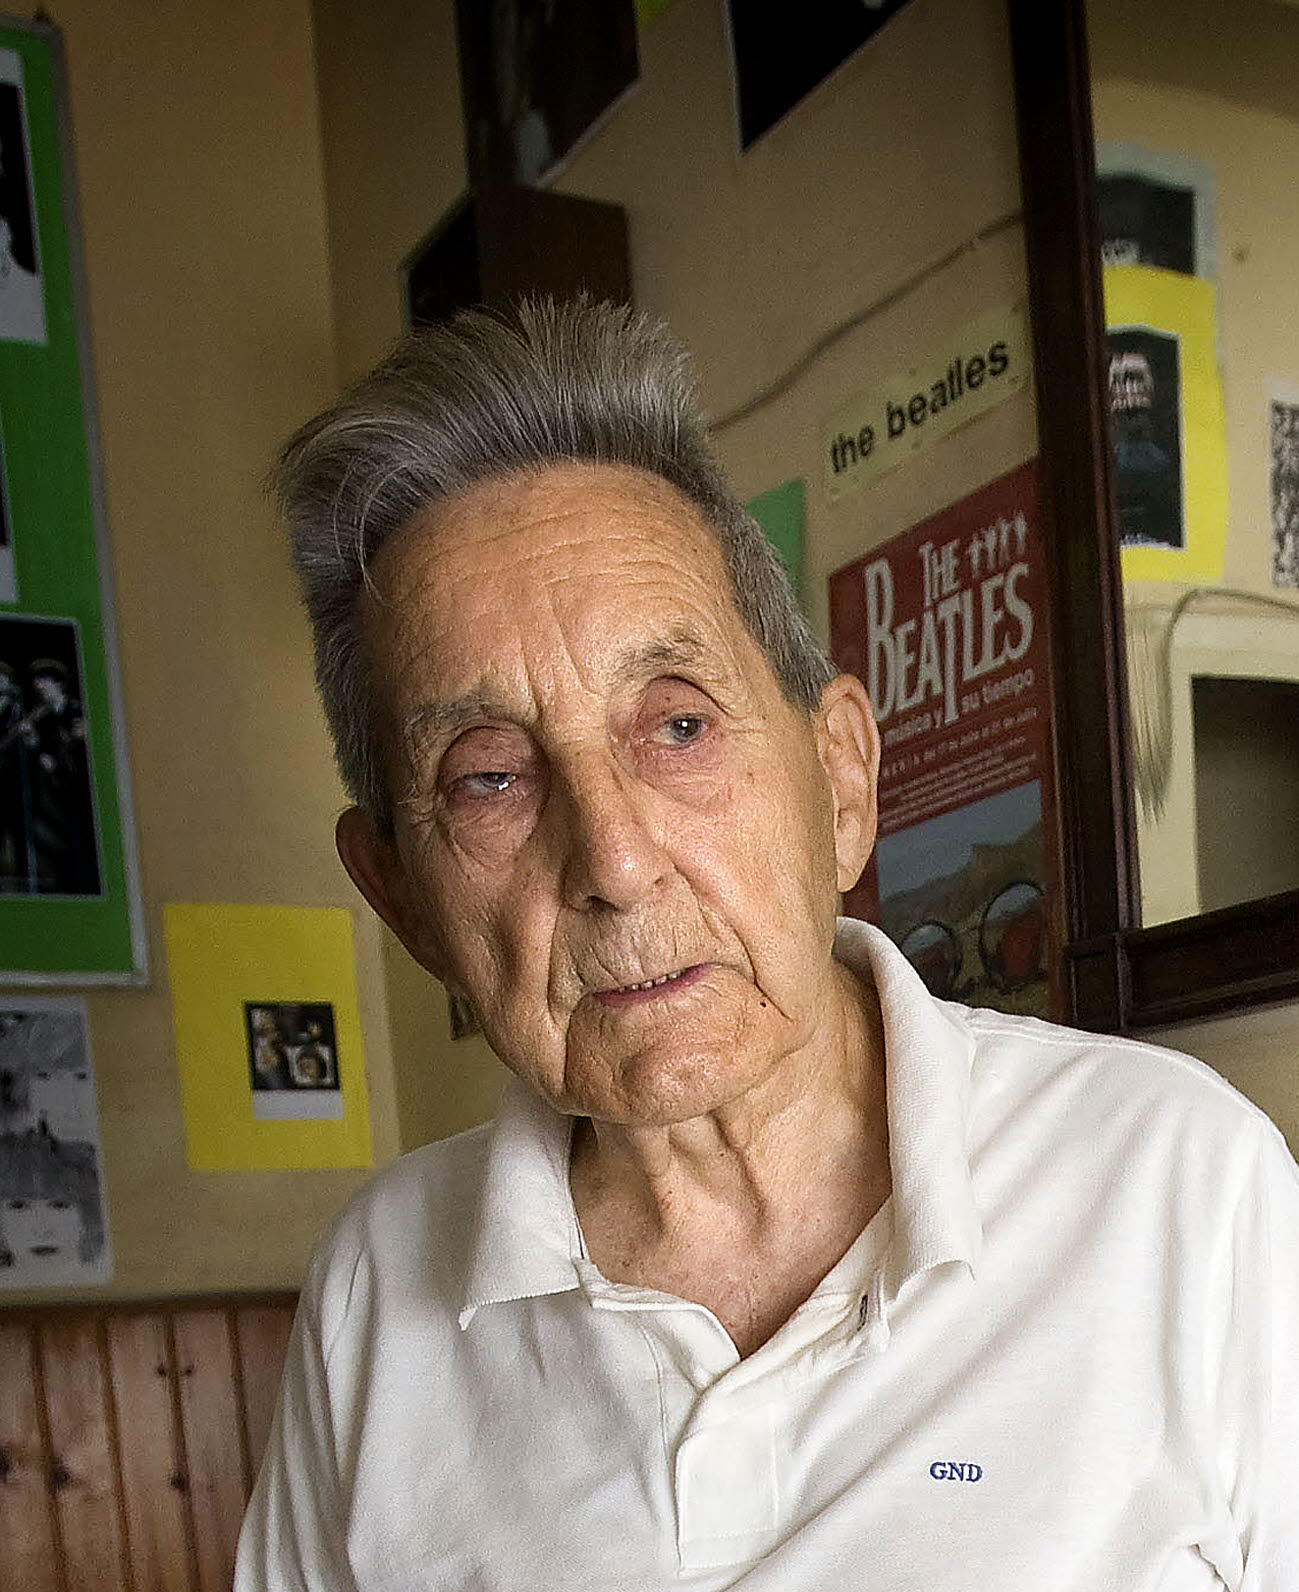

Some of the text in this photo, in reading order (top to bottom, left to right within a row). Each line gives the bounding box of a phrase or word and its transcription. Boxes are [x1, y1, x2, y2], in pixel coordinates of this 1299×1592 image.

[829, 341, 1009, 474] the beatles
[918, 539, 961, 609] THE
[865, 559, 1035, 725] BEATLES
[930, 1461, 982, 1482] GND
